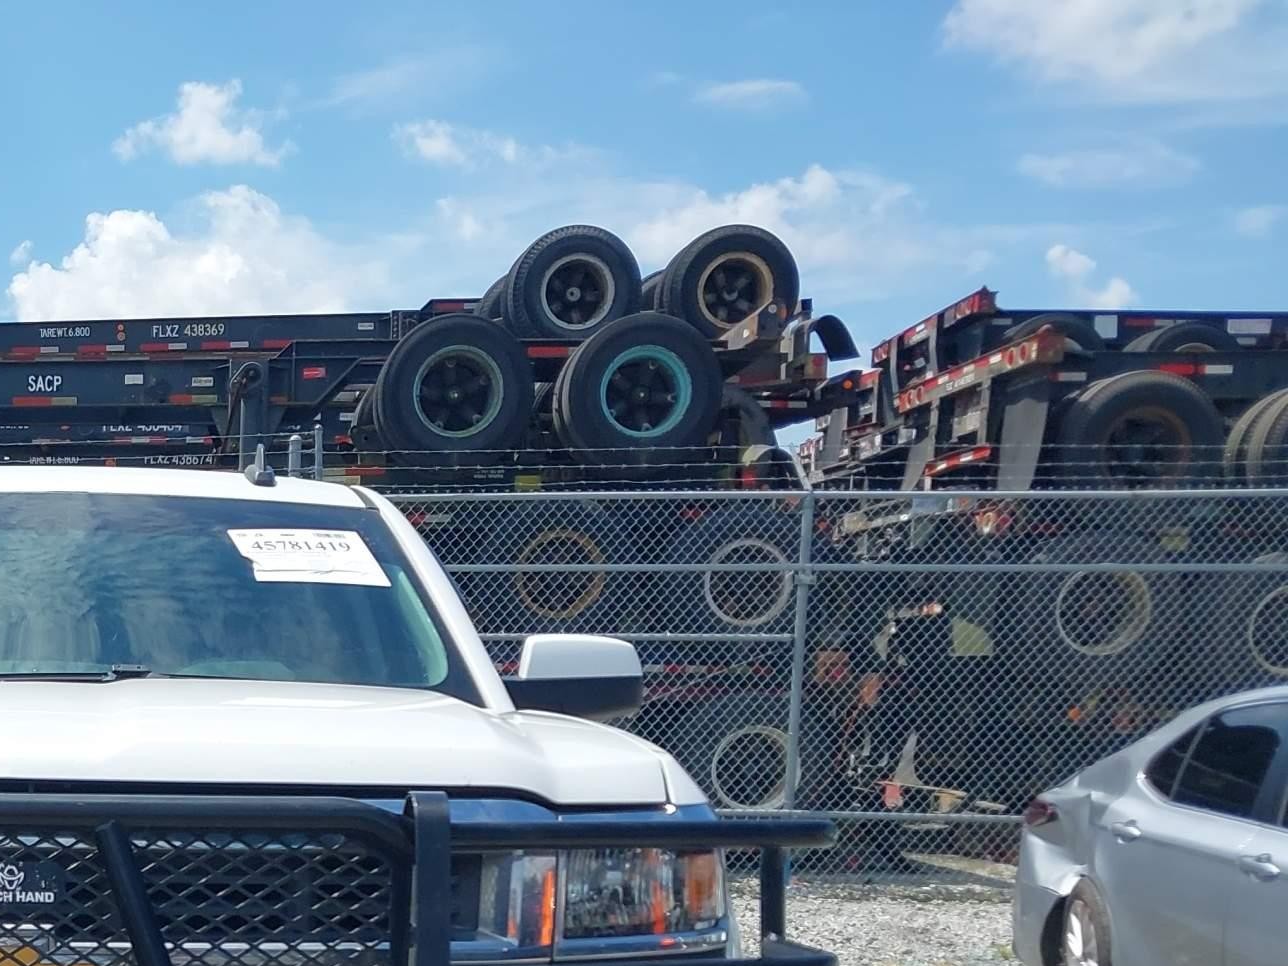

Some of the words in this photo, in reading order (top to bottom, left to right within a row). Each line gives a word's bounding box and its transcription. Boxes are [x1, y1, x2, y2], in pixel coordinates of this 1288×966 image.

[152, 325, 179, 338] FLXZ
[183, 324, 225, 336] 438369
[27, 375, 63, 392] SACP
[251, 540, 351, 552] 45781419
[16, 891, 55, 903] HAND
